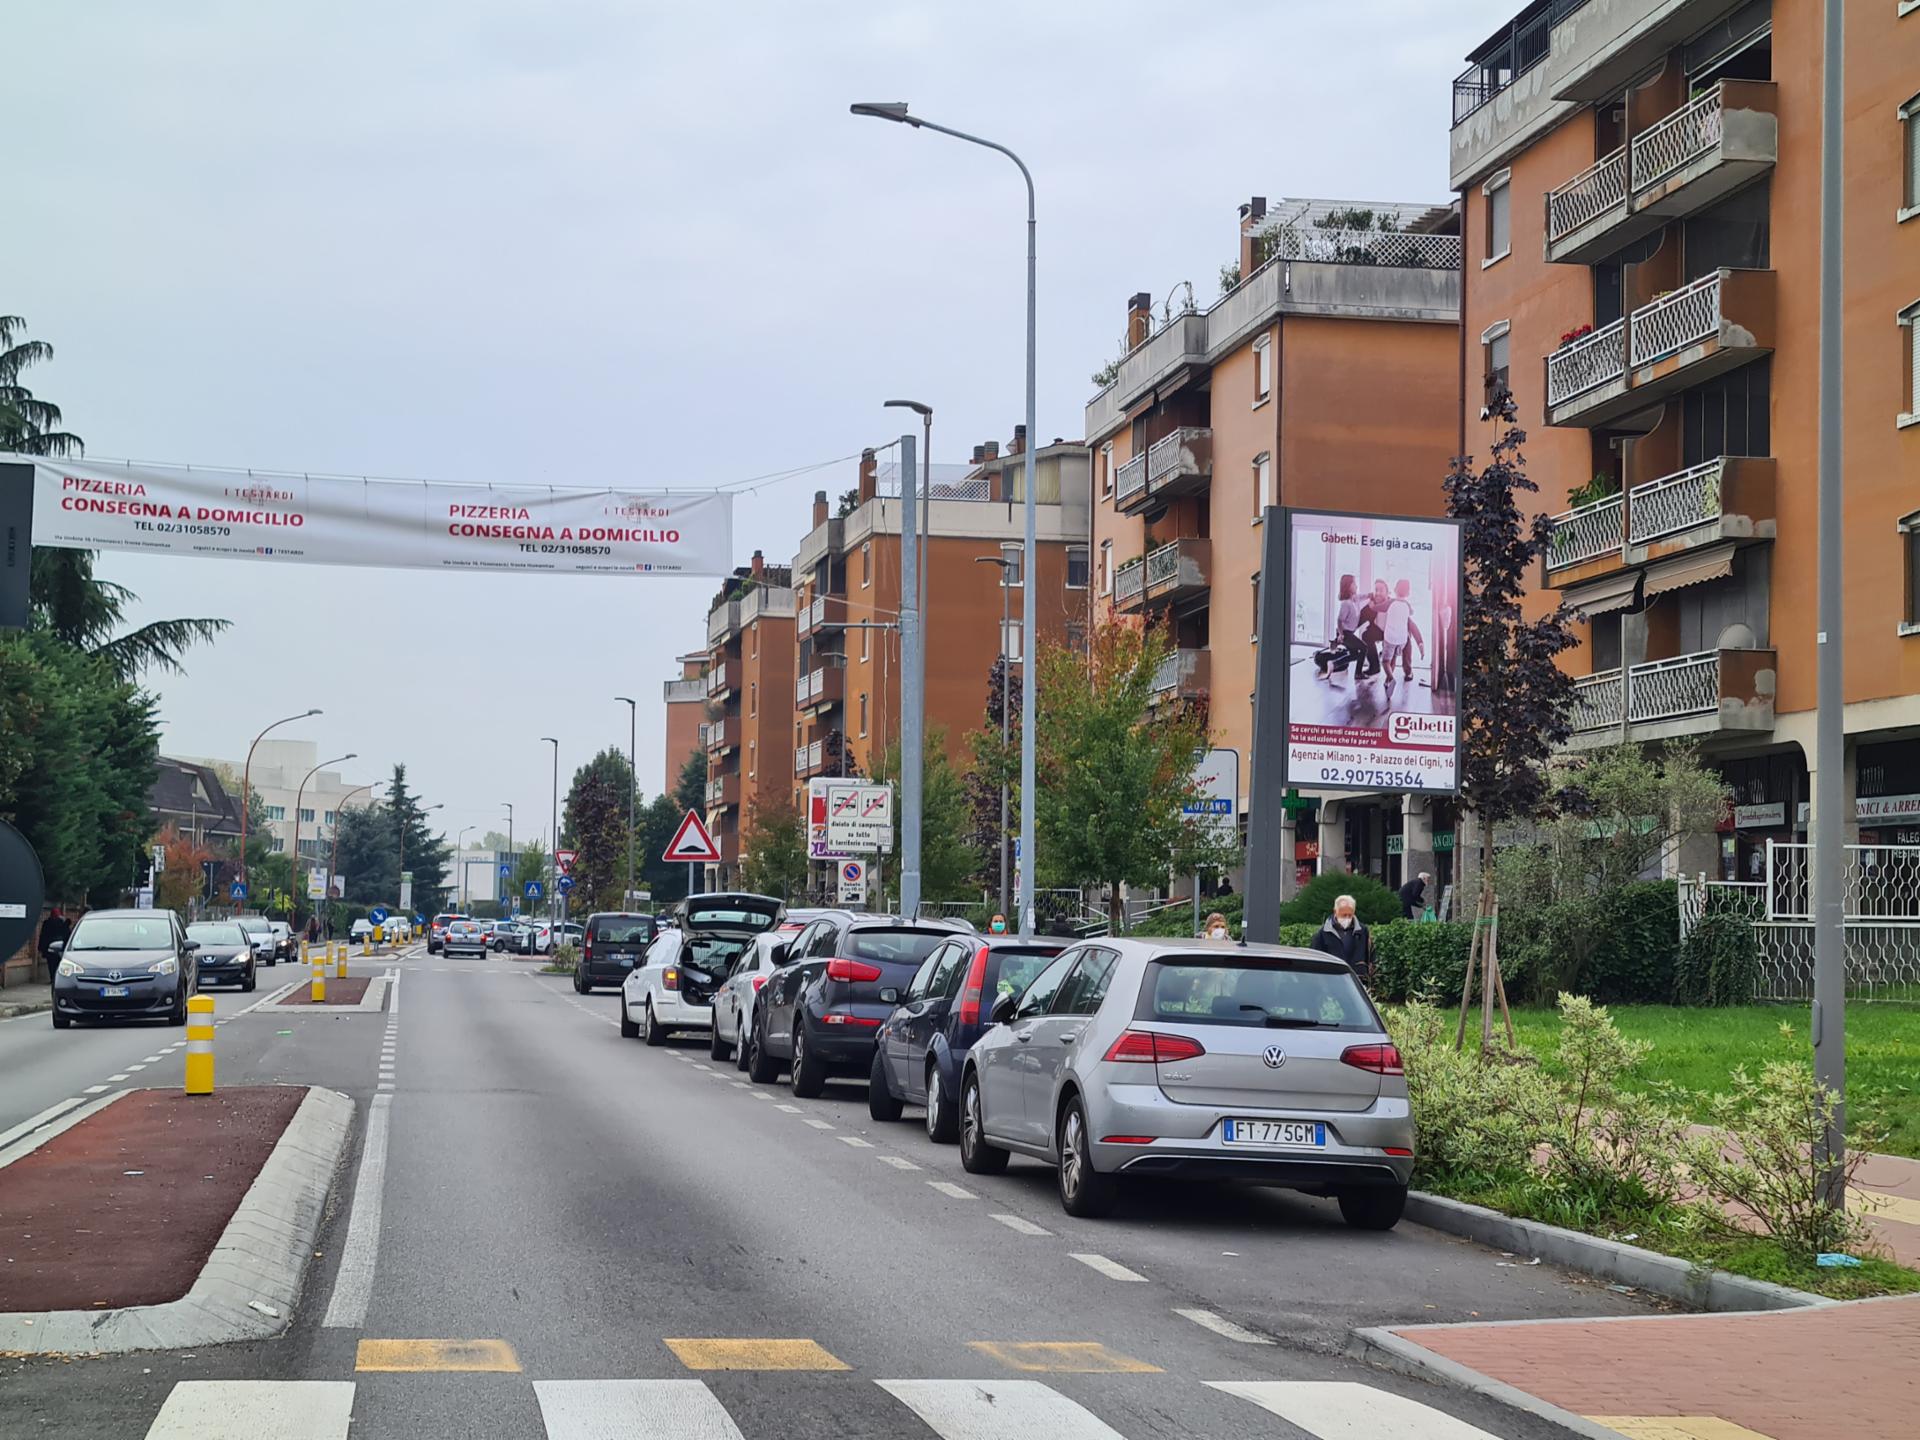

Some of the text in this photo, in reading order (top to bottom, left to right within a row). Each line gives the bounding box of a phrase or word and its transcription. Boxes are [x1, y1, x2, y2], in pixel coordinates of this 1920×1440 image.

[63, 476, 146, 496] PIZZERIA
[235, 489, 293, 501] TESTARDI
[61, 497, 304, 527] CONSEGNA A DOMICILIO
[449, 504, 530, 520] PIZZERIA
[615, 508, 669, 517] TESTARDI
[135, 521, 230, 536] TEL 02/31058570
[448, 523, 680, 543] CONSEGNA A DOMICILIO
[520, 544, 611, 555] TEL 02/31058570
[1321, 532, 1433, 551] Gabetti. E sei già a casa
[1300, 726, 1320, 734] cerchi
[1326, 727, 1343, 735] vendi
[1360, 729, 1382, 738] Gabetti
[1394, 716, 1453, 741] gabetti
[1307, 735, 1337, 744] soluzione
[1291, 748, 1325, 762] Agenzia
[1327, 750, 1355, 762] Milano
[1357, 754, 1362, 764] 3
[1370, 753, 1403, 766] Palazzo
[1404, 755, 1417, 766] dei
[1419, 756, 1442, 769] Cigni,
[1445, 758, 1454, 768] 16
[1321, 768, 1424, 788] 02.90753564
[1856, 799, 1920, 816] RNICI & ARRE
[1387, 836, 1403, 852] FARM
[1442, 834, 1454, 847] GIO
